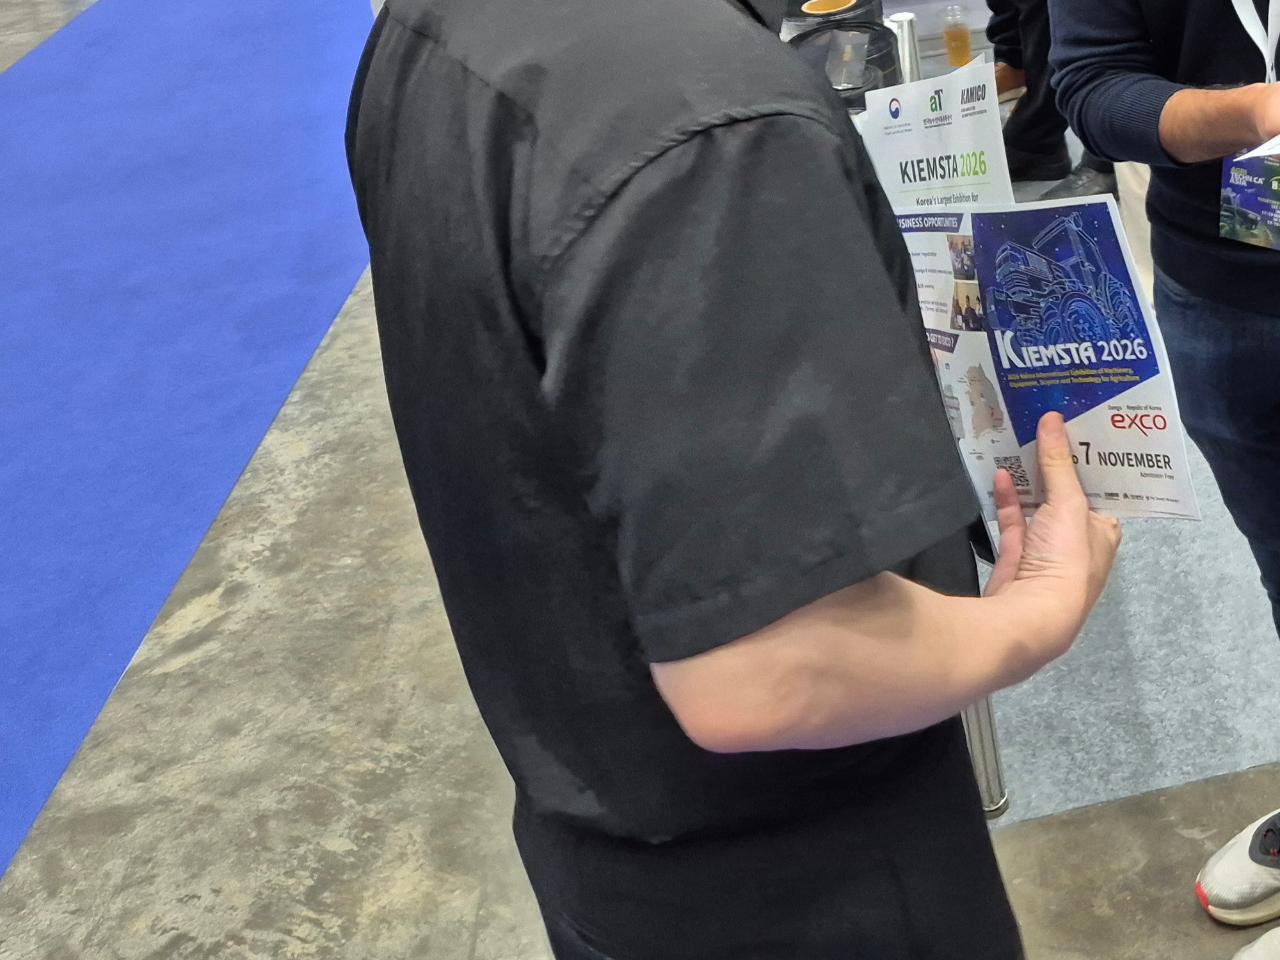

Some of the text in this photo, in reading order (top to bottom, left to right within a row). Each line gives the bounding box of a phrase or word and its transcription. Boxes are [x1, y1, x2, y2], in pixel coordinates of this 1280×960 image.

[899, 150, 988, 185] KIEMSTA 2026
[899, 217, 923, 230] SINESS
[994, 328, 1148, 370] KIEMSTA 2026
[1110, 413, 1167, 437] exco
[1071, 441, 1173, 471] o 7 NOVEMBER
